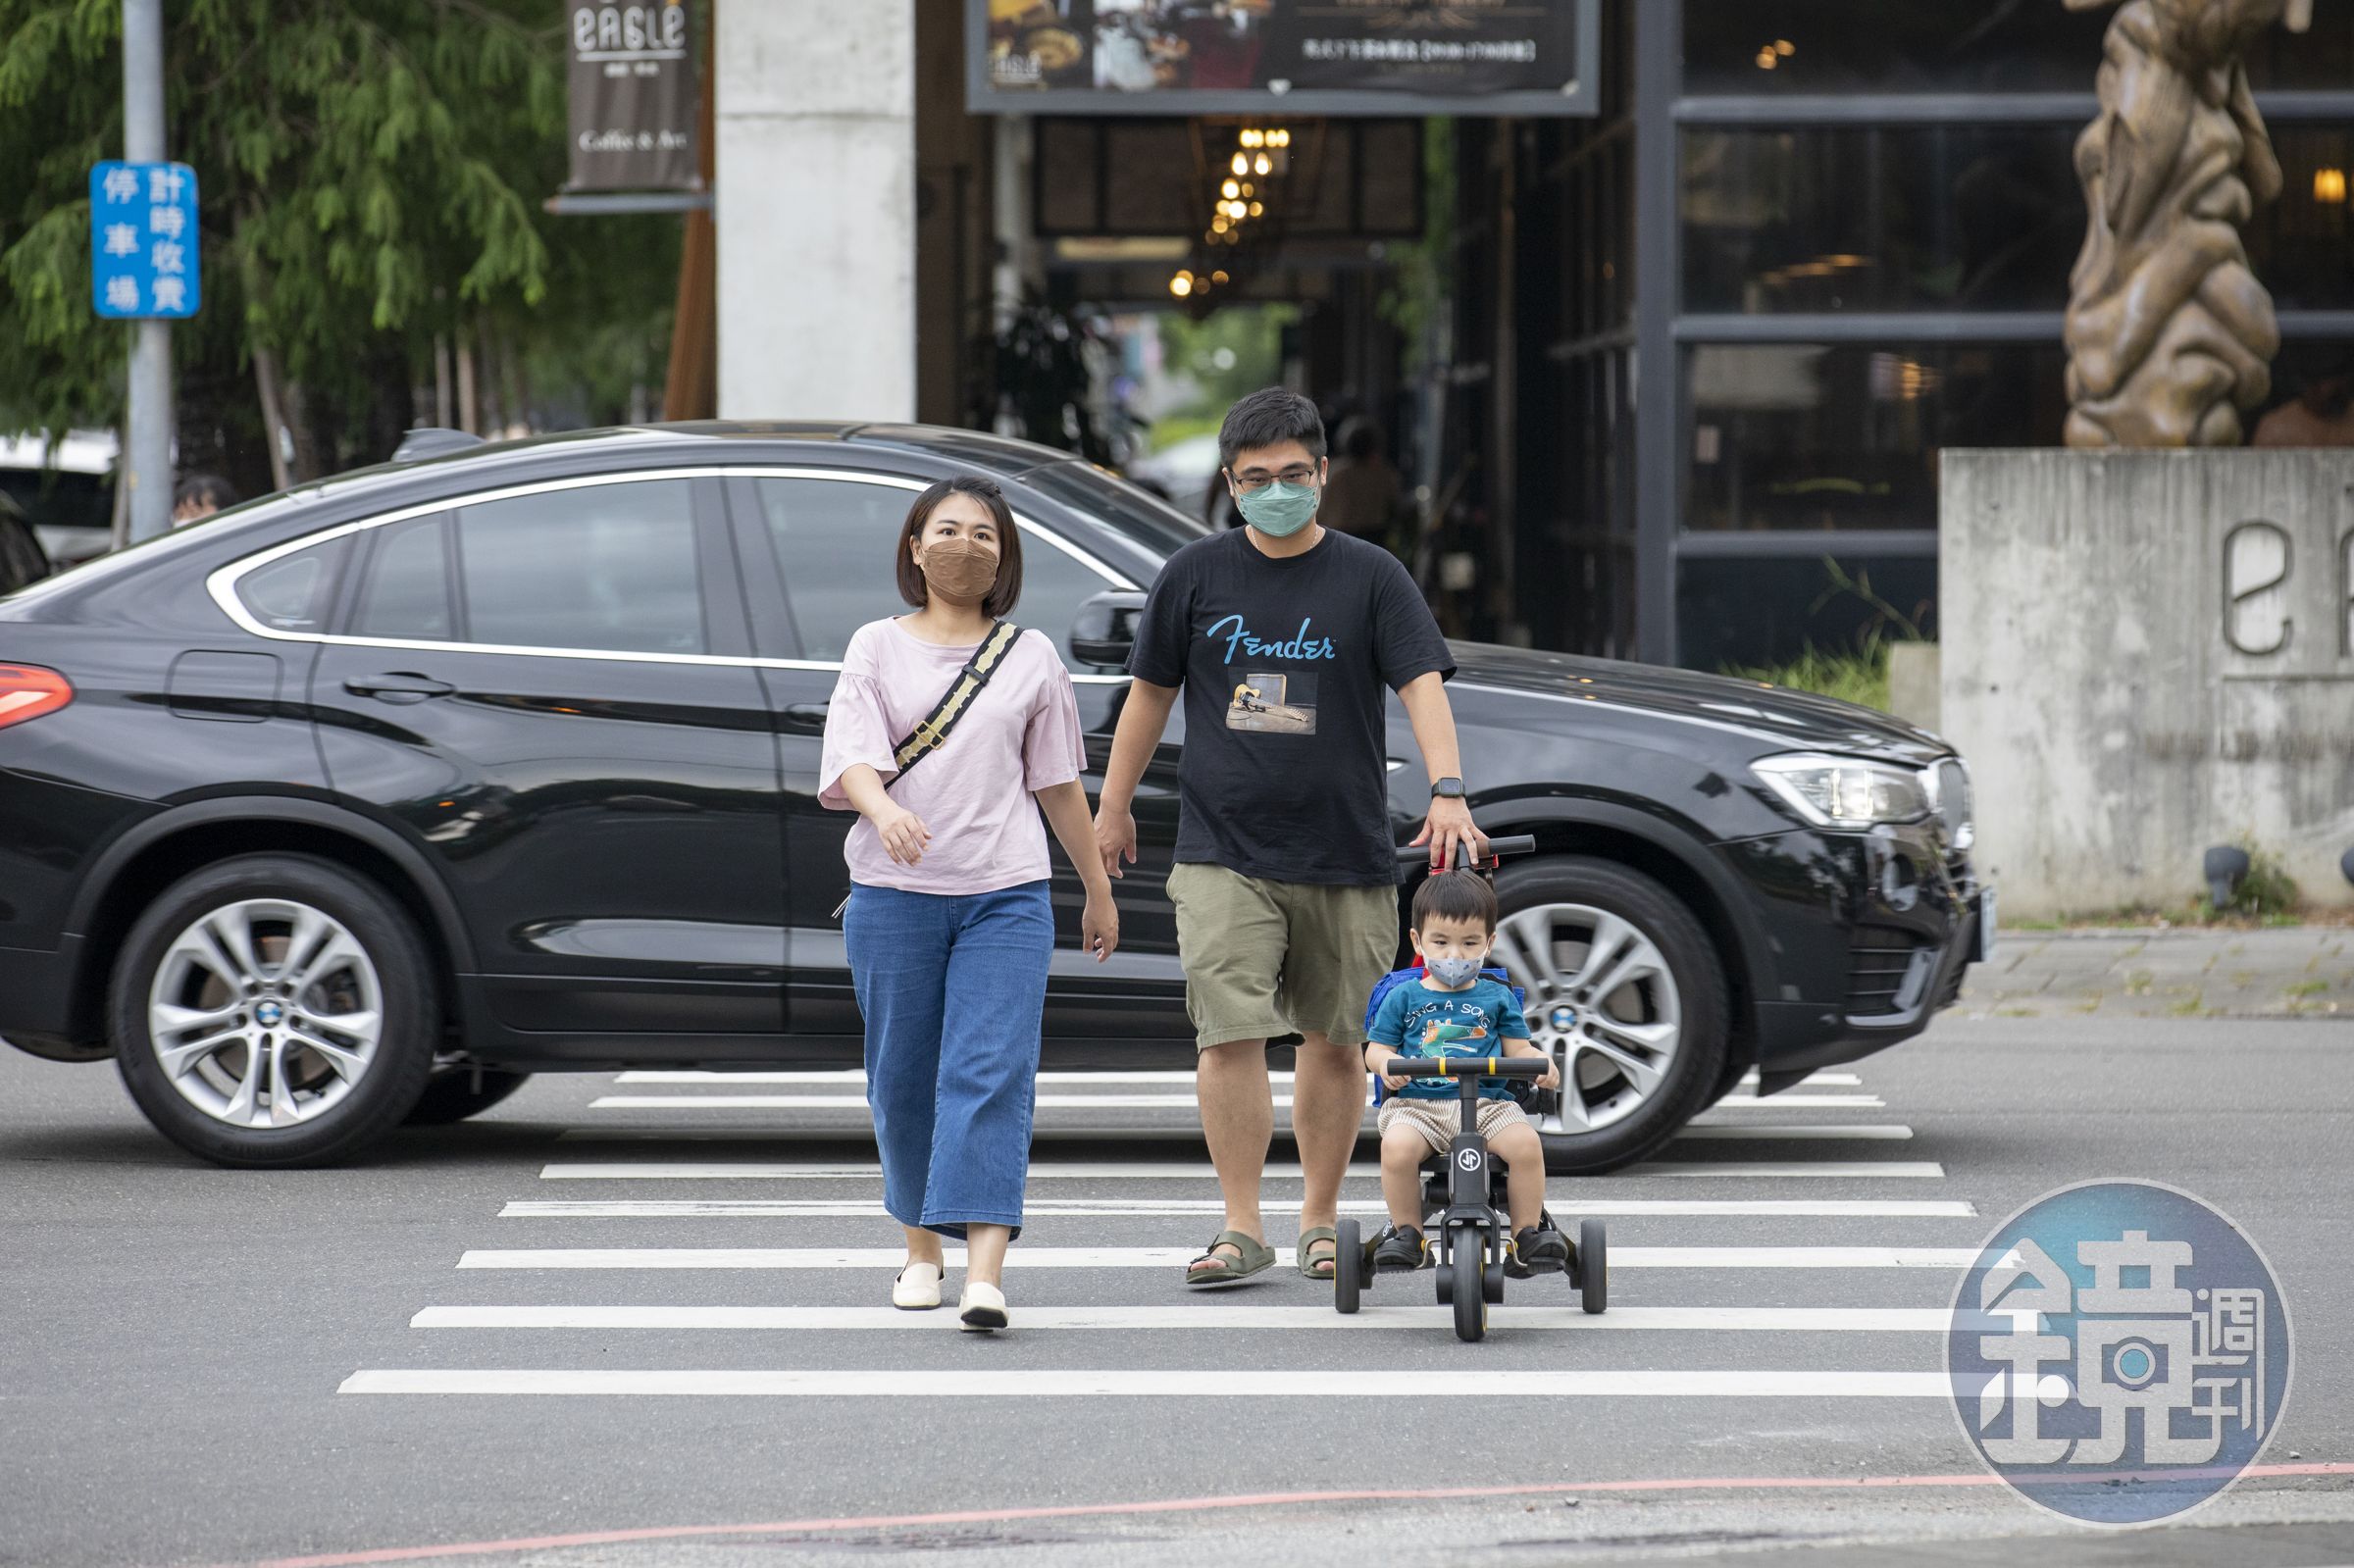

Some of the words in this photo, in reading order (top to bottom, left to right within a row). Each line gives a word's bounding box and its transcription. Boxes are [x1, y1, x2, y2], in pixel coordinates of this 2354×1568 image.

[102, 167, 140, 313] 停車場
[149, 167, 186, 313] 計時收費
[1206, 614, 1335, 665] Fender
[1404, 1002, 1438, 1029] SING
[1444, 999, 1454, 1011] A
[1460, 1003, 1491, 1030] SONG
